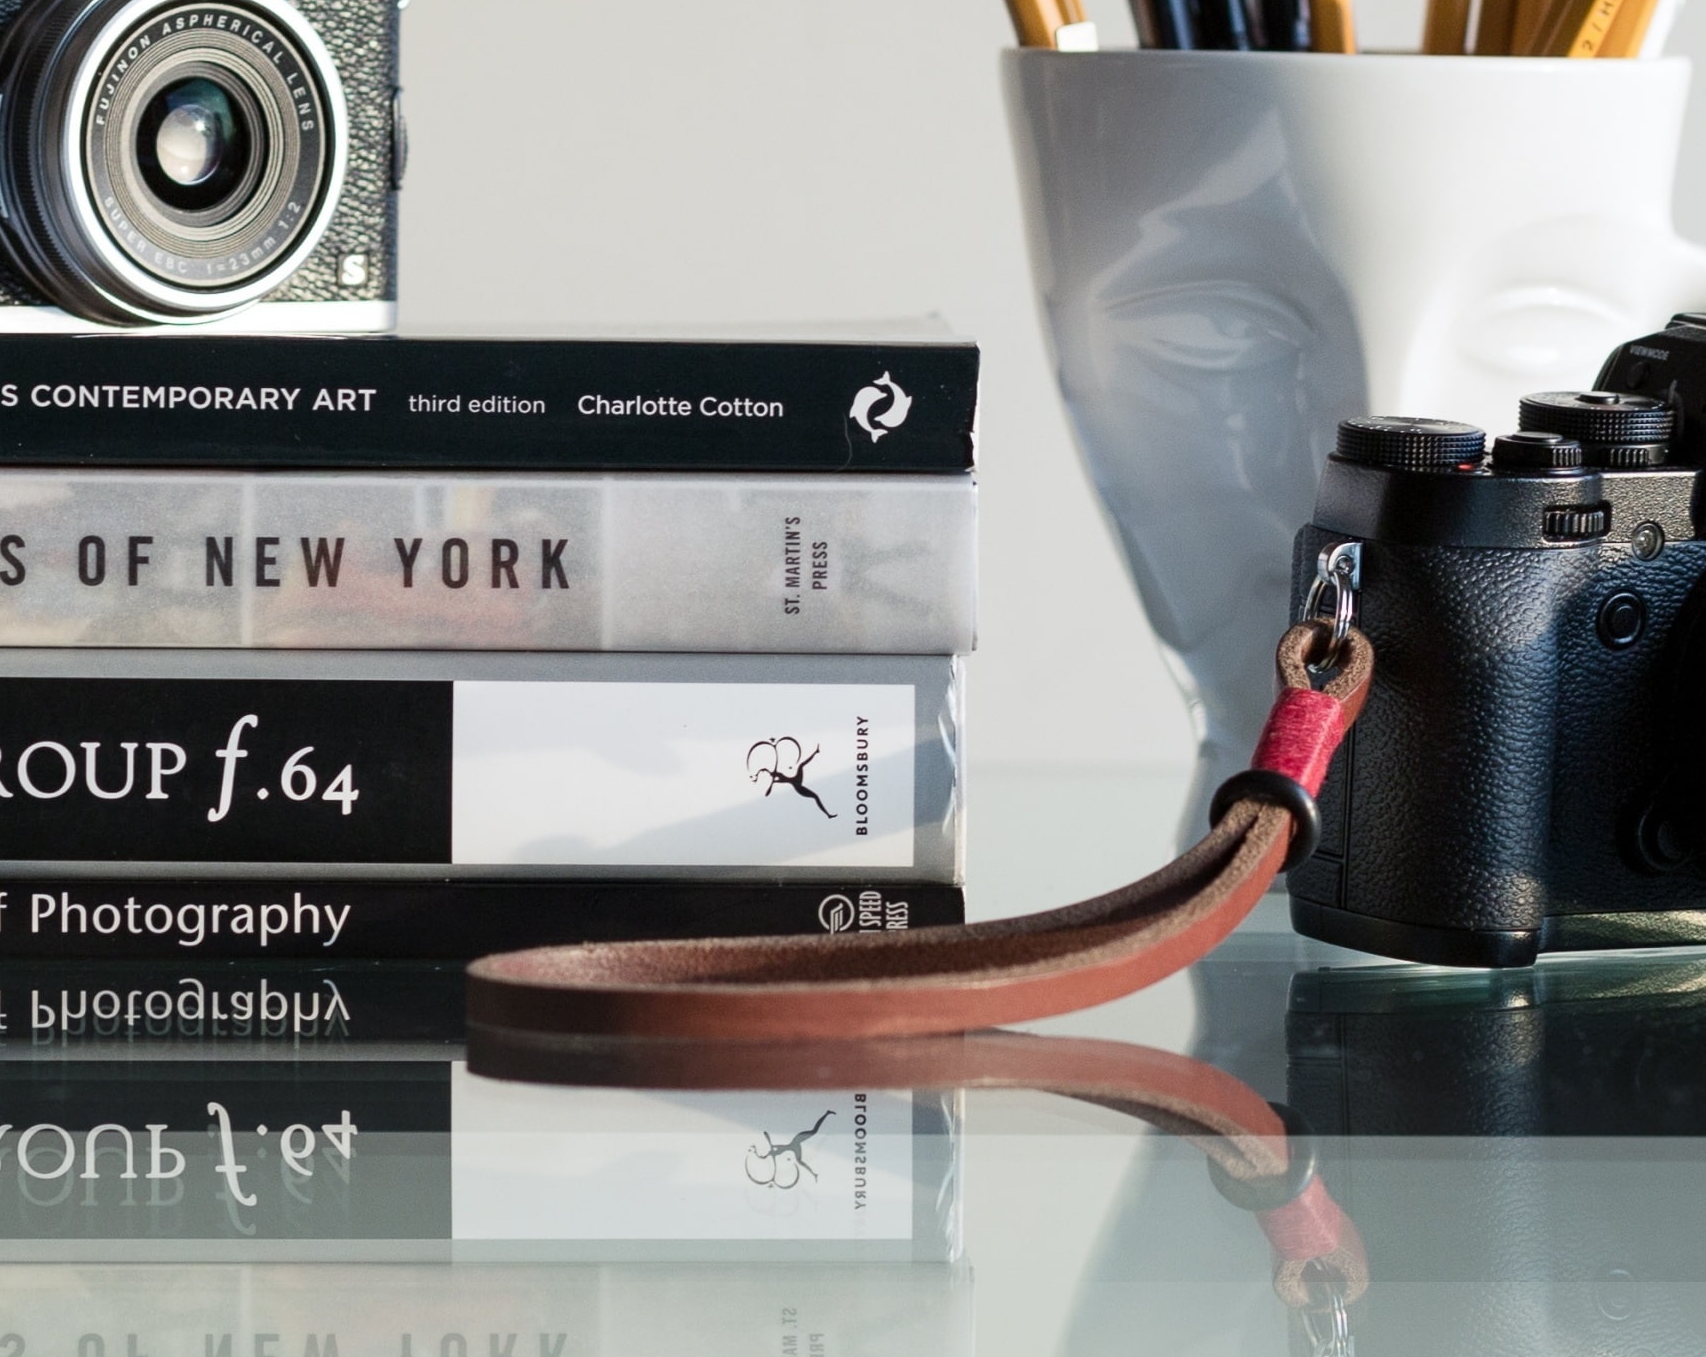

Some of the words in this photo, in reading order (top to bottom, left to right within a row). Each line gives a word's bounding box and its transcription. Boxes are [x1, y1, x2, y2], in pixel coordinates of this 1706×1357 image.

[95, 35, 151, 126] FUJINON
[162, 13, 283, 65] ASPHERICAL
[287, 71, 314, 131] LENS
[103, 196, 147, 252] SUPER
[154, 250, 187, 274] EBC
[206, 235, 276, 274] f=23mm
[278, 200, 302, 230] 1:2
[341, 255, 366, 285] S
[30, 384, 301, 411] CONTEMPORARY
[312, 388, 377, 412] ART
[408, 394, 459, 413] third
[468, 395, 546, 414] edition
[577, 394, 692, 416] Charlotte
[699, 396, 784, 417] Cotton
[77, 534, 154, 587] OF
[205, 536, 345, 588] NEW
[393, 537, 570, 590] YORK
[784, 516, 801, 576] MARTIN'S
[811, 541, 828, 590] PRESS
[784, 585, 801, 615] ST.
[207, 713, 360, 823] f.64
[855, 716, 869, 836] BLOOMSBURY
[31, 891, 351, 947] Photography
[858, 890, 882, 927] SPEED
[885, 901, 909, 933] RESS
